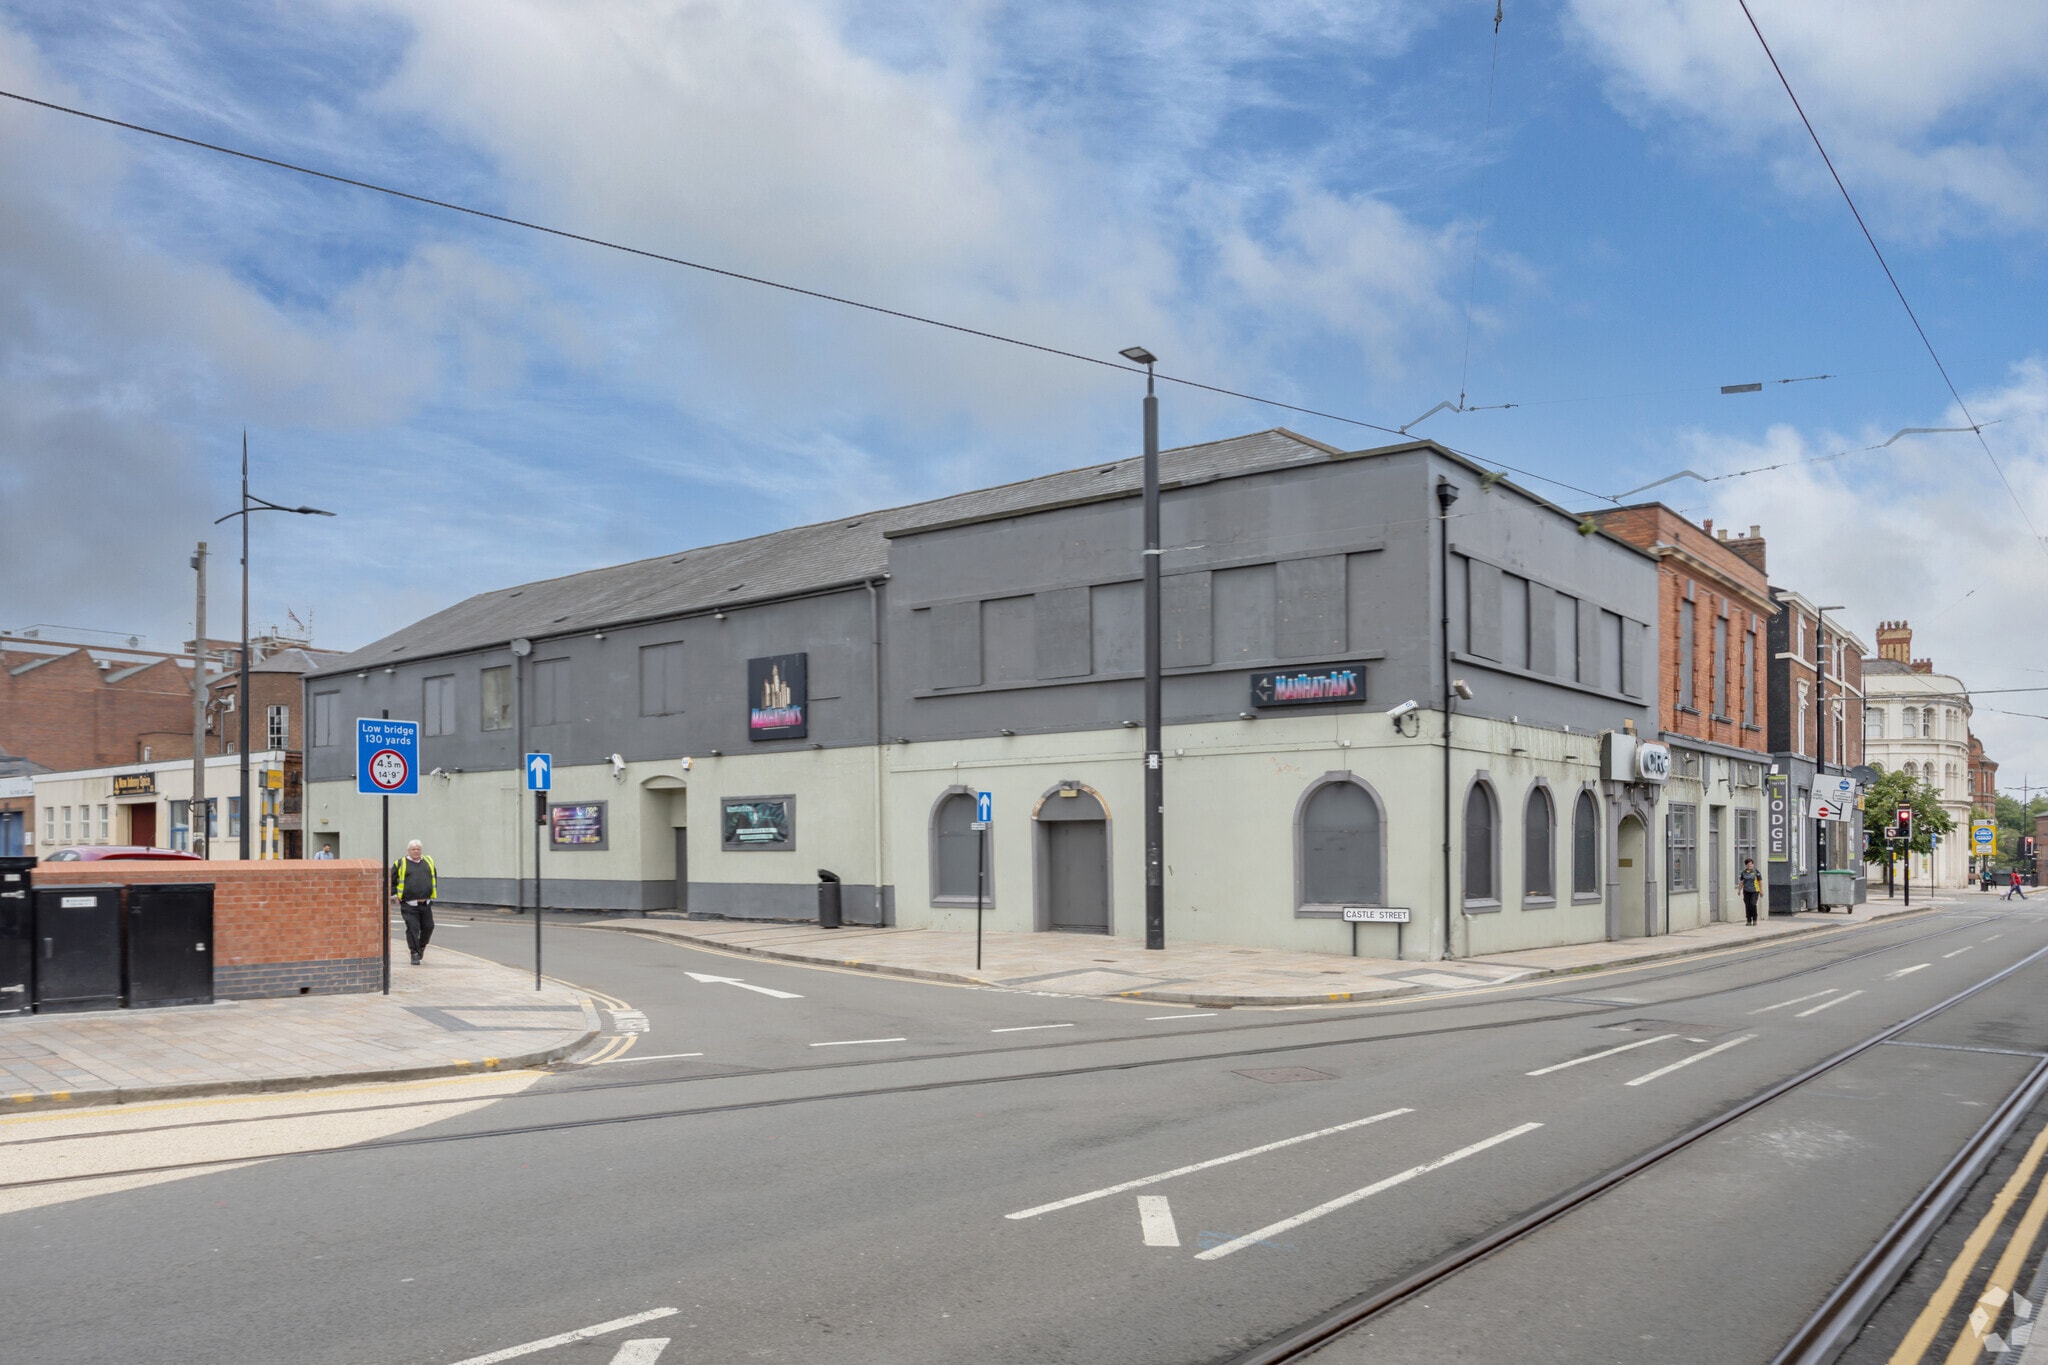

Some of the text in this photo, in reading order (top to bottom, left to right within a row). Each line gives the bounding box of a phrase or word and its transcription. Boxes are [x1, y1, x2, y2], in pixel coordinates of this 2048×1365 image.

[362, 723, 414, 736] Low bridge
[365, 734, 411, 745] 130 yards
[377, 759, 392, 768] 4.5
[1771, 787, 1784, 852] LODGE
[1346, 911, 1407, 919] CASTLE STREET
